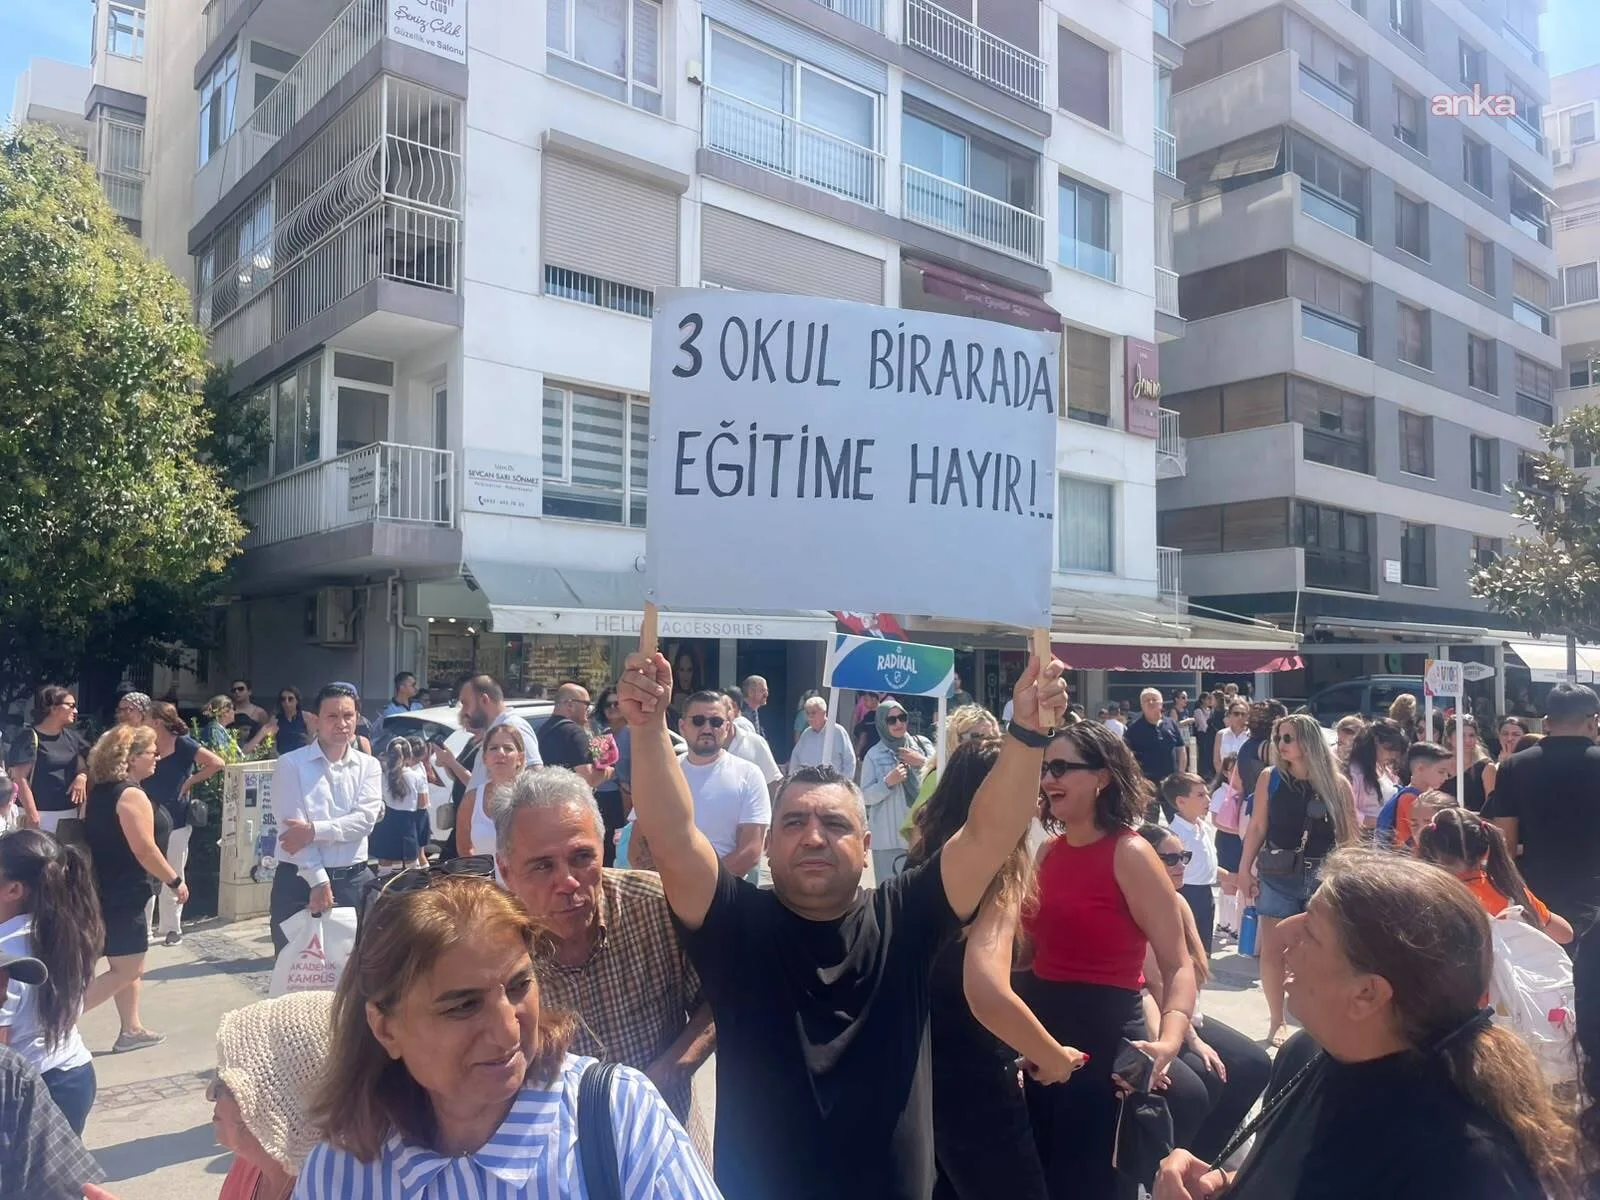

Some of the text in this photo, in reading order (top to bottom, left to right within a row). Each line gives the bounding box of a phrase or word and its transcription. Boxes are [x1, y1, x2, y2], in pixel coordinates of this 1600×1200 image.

[436, 40, 464, 56] Salonu
[671, 312, 1054, 414] 3 OKUL BİRARADA
[674, 419, 876, 501] EĞİTİME
[595, 615, 764, 635] HELL ACCESSORIES
[1181, 654, 1216, 670] Outlet
